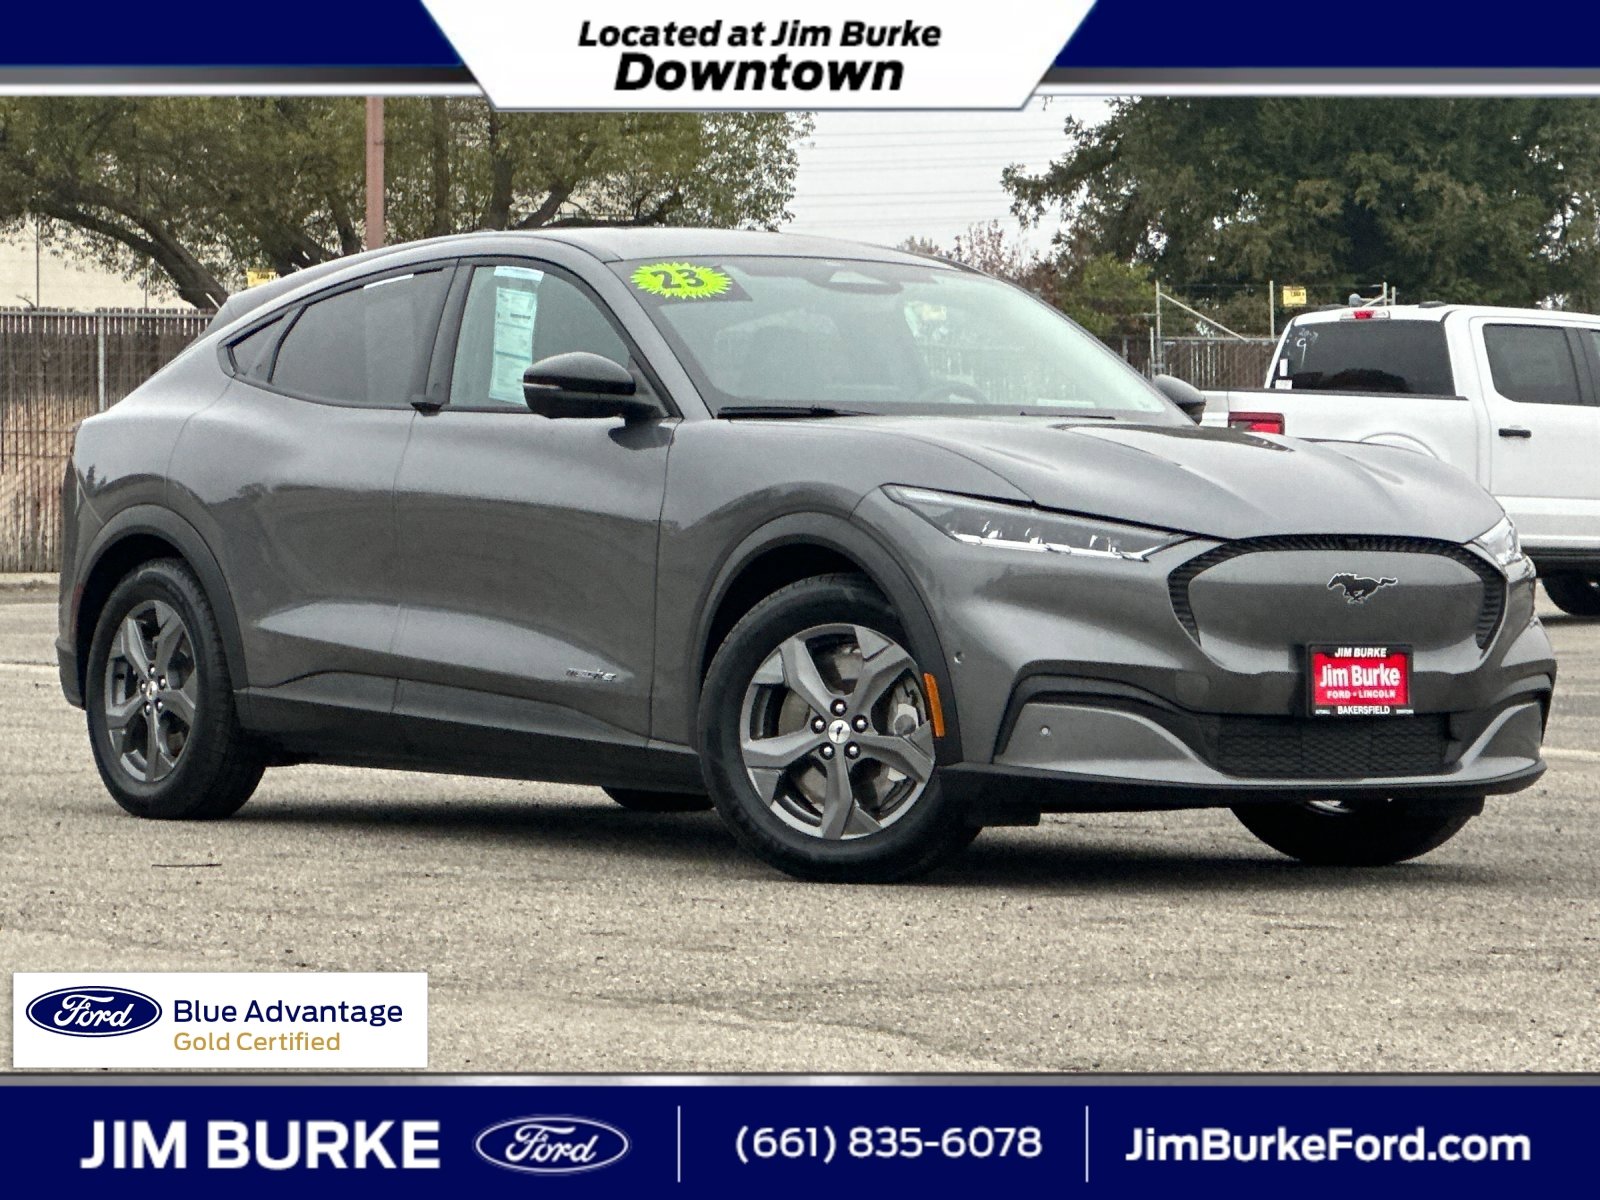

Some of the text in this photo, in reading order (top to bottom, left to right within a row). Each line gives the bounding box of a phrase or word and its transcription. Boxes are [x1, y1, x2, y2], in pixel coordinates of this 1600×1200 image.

[650, 269, 705, 289] 23
[1334, 648, 1387, 658] JIM BURKE
[1320, 663, 1400, 687] Jim Burke
[1327, 690, 1396, 699] FORD LINCOLN
[1337, 705, 1391, 715] BAKERSFIELD
